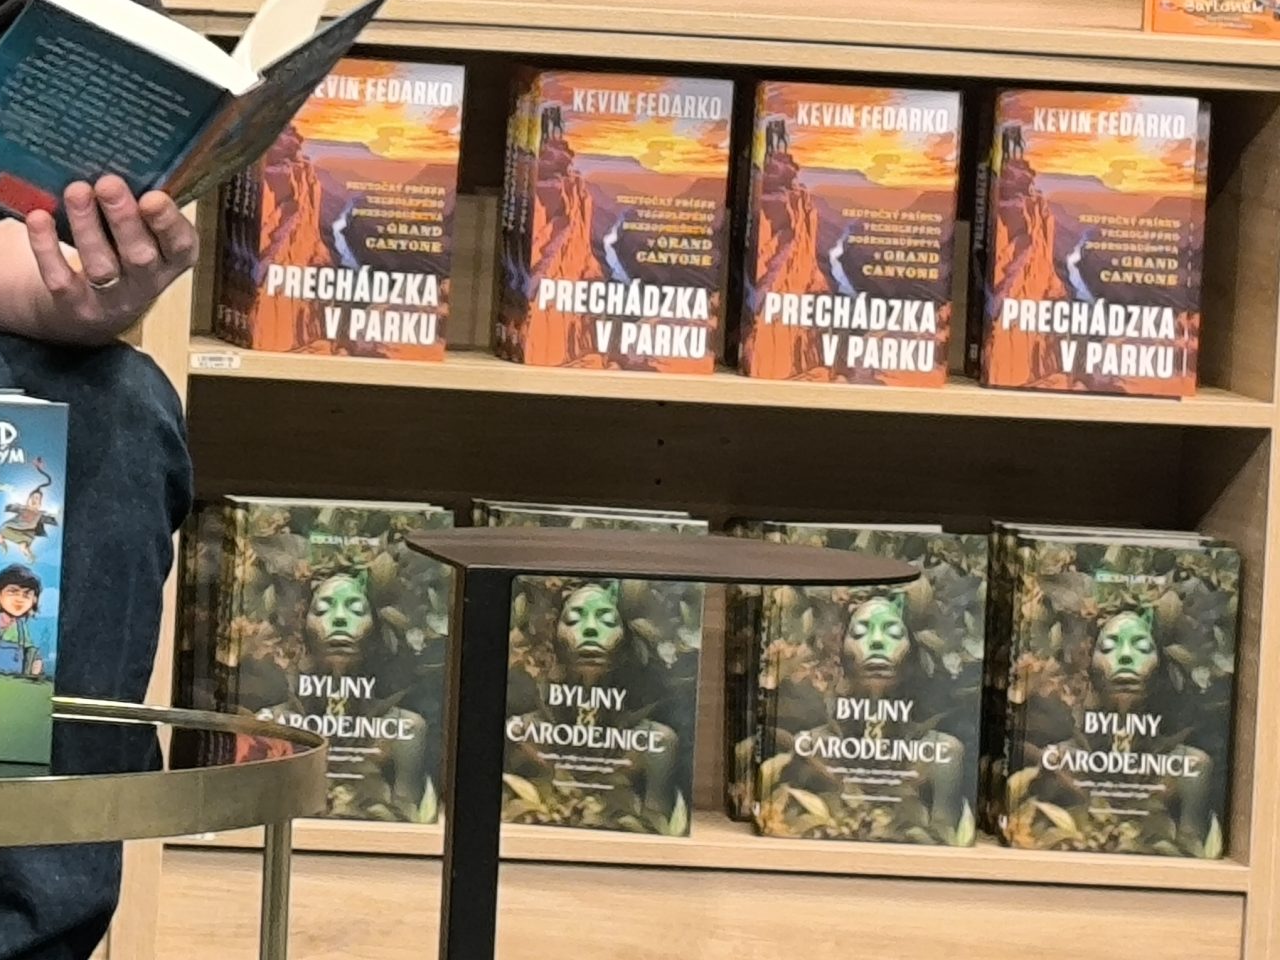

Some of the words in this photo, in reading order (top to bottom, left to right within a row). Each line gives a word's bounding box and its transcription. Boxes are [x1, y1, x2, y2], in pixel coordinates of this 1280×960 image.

[310, 74, 359, 101] EVIN
[366, 77, 453, 107] FEDARKO
[572, 88, 632, 115] KEVIN
[636, 92, 722, 120] FEDARKO
[796, 101, 855, 127] KEVIN
[860, 105, 949, 133] FEDARKO
[1033, 107, 1092, 134] KEVIN
[1097, 111, 1186, 140] FEDARKO
[365, 237, 443, 253] CANYONE
[386, 222, 442, 237] GRAND
[656, 236, 713, 250] GRAND
[636, 250, 713, 266] CANYONE
[862, 264, 939, 280] CANYONE
[883, 250, 940, 264] GRAND
[1121, 256, 1178, 270] GRAND
[267, 263, 438, 307] PRECHÁDZKA
[1100, 270, 1178, 286] CANYONE
[538, 278, 709, 320] PRECHÁDZKA
[764, 291, 937, 334] PRECHÁDZKA
[324, 307, 342, 340] V
[349, 308, 437, 346] PARKU
[1001, 297, 1176, 340] PRECHÁDZKA
[595, 321, 613, 354] V
[620, 322, 708, 360] PARKU
[821, 334, 840, 367] V
[847, 335, 935, 372] PARKU
[1060, 340, 1078, 373] V
[1086, 343, 1174, 378] PARKU
[298, 674, 376, 699] BYLINY
[549, 684, 627, 710] BYLINY
[836, 698, 914, 722] BYLINY
[1084, 712, 1162, 738] BYLINY
[506, 716, 668, 754] ČARODEJNICE
[794, 731, 952, 764] ČARODEJNICE
[1042, 744, 1202, 778] ČARODEJNICE
